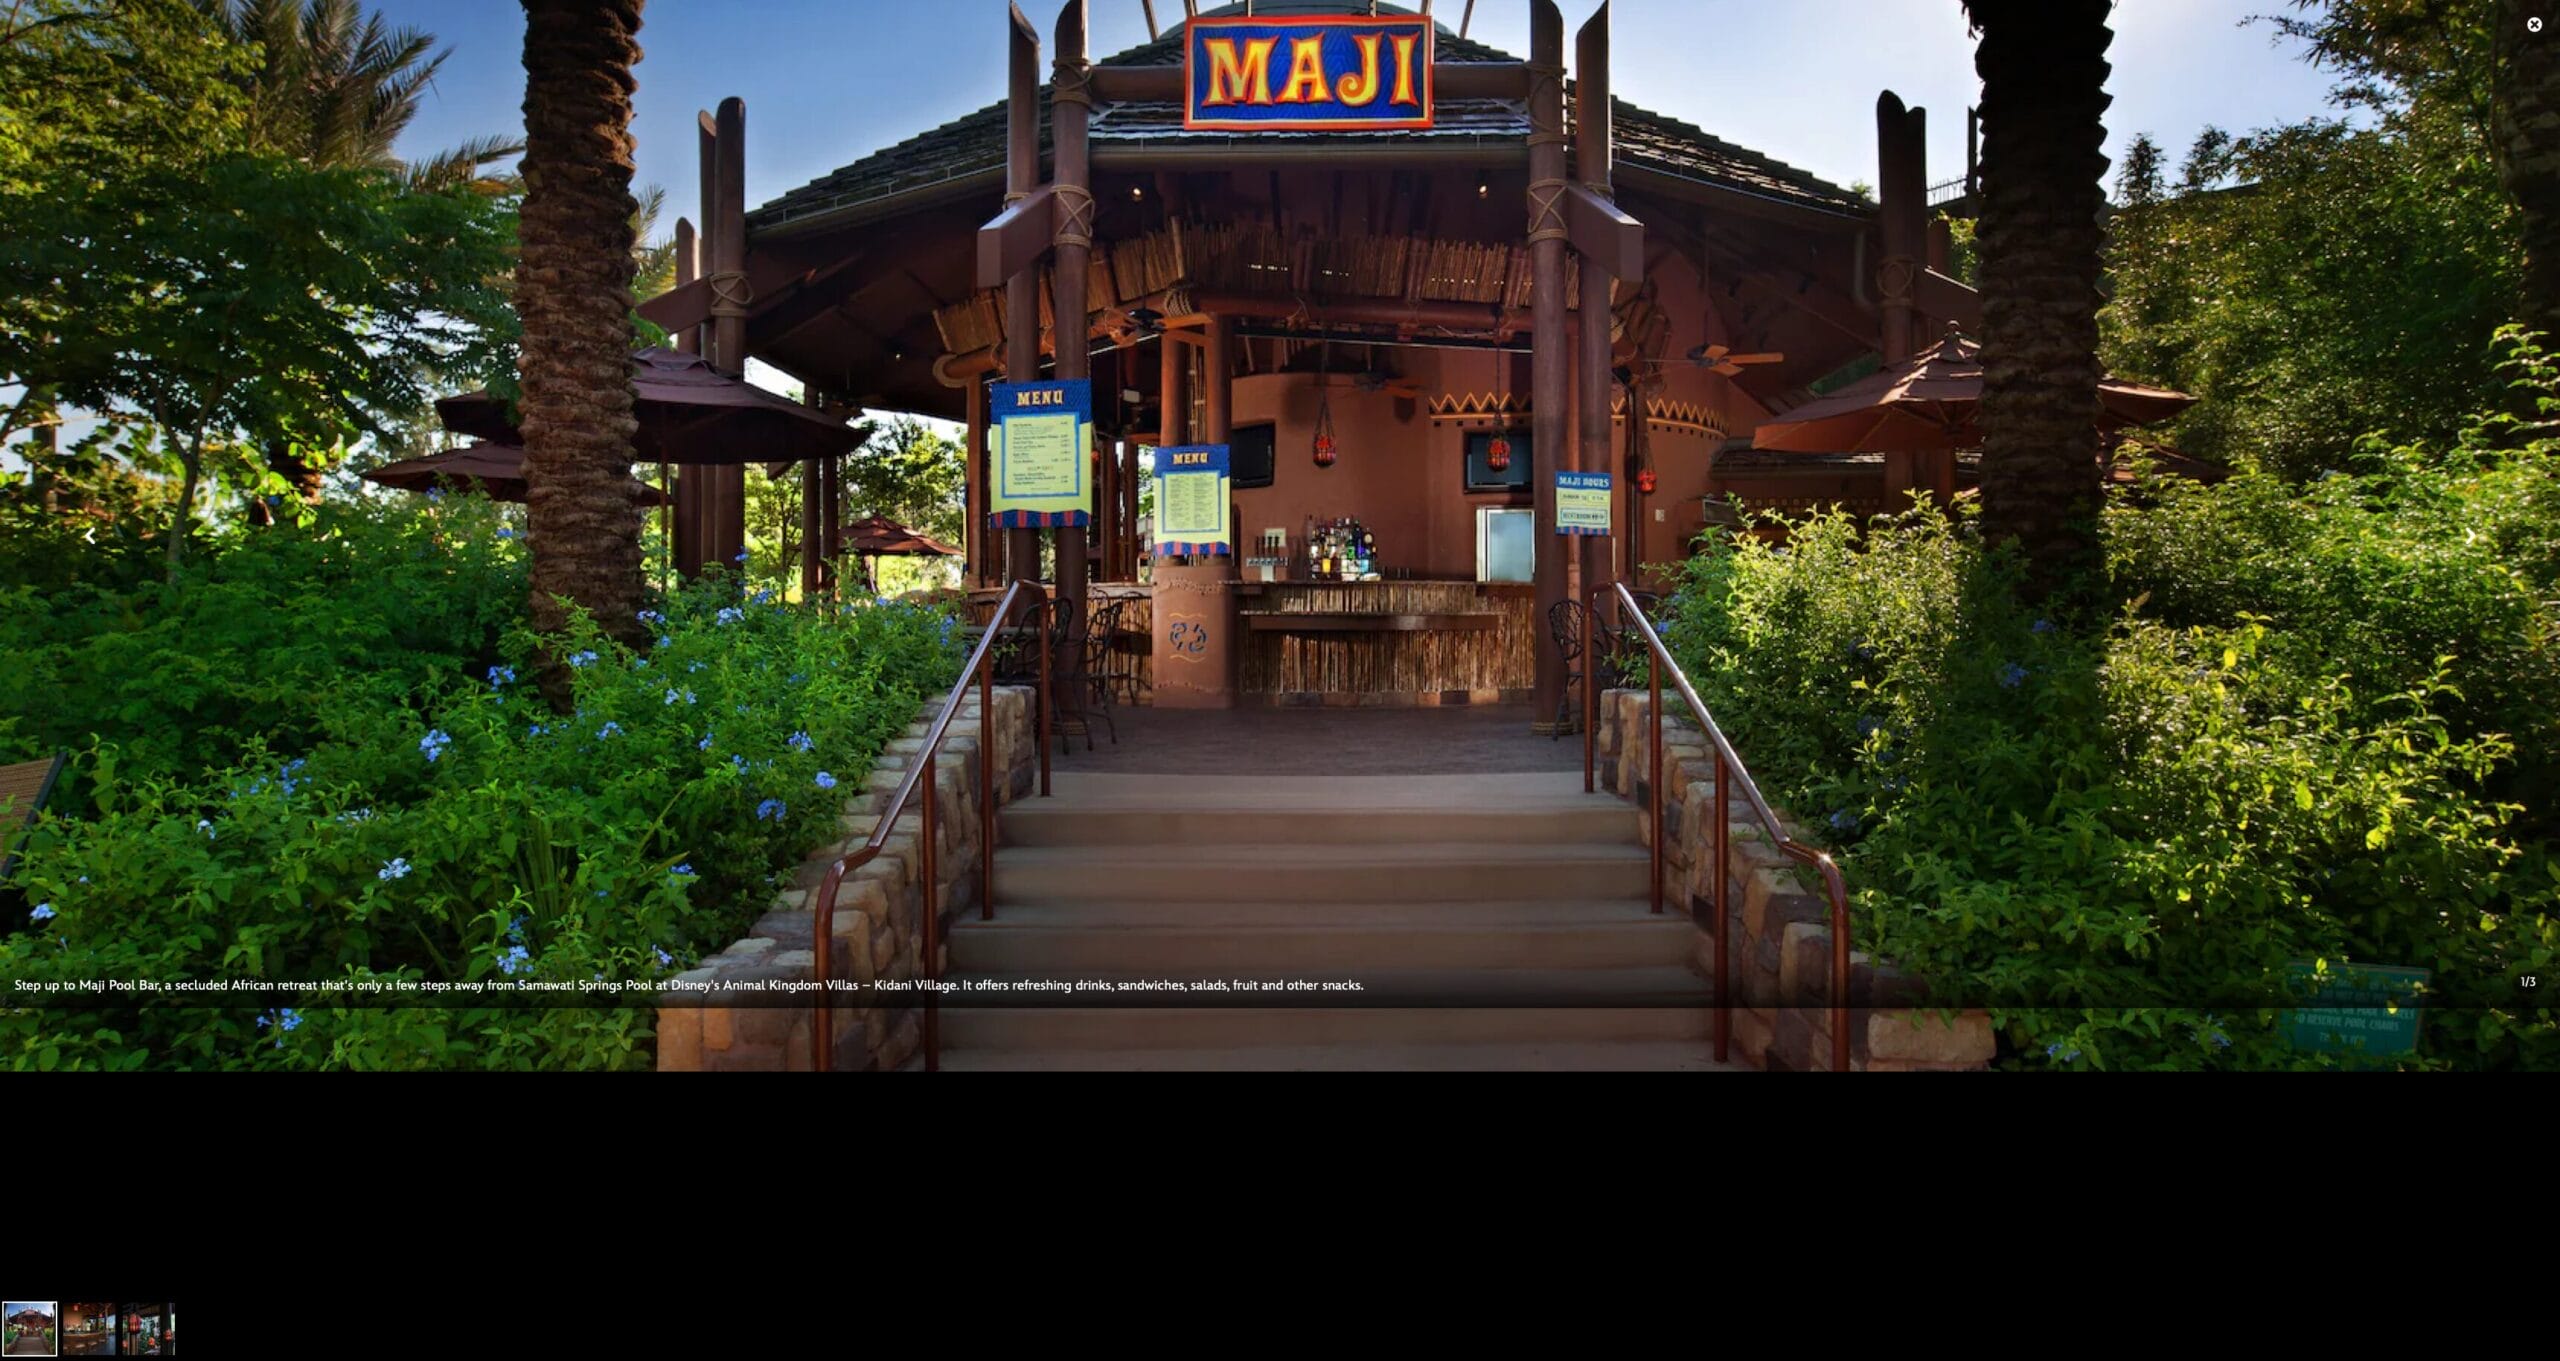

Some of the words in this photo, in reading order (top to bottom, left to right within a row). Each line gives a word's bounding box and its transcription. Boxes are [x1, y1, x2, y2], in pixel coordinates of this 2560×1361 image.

[1202, 31, 1420, 107] MAJI
[1016, 389, 1064, 406] MENU
[1173, 452, 1208, 465] MENU
[1558, 476, 1581, 487] MAJI
[1583, 477, 1610, 489] HOURS
